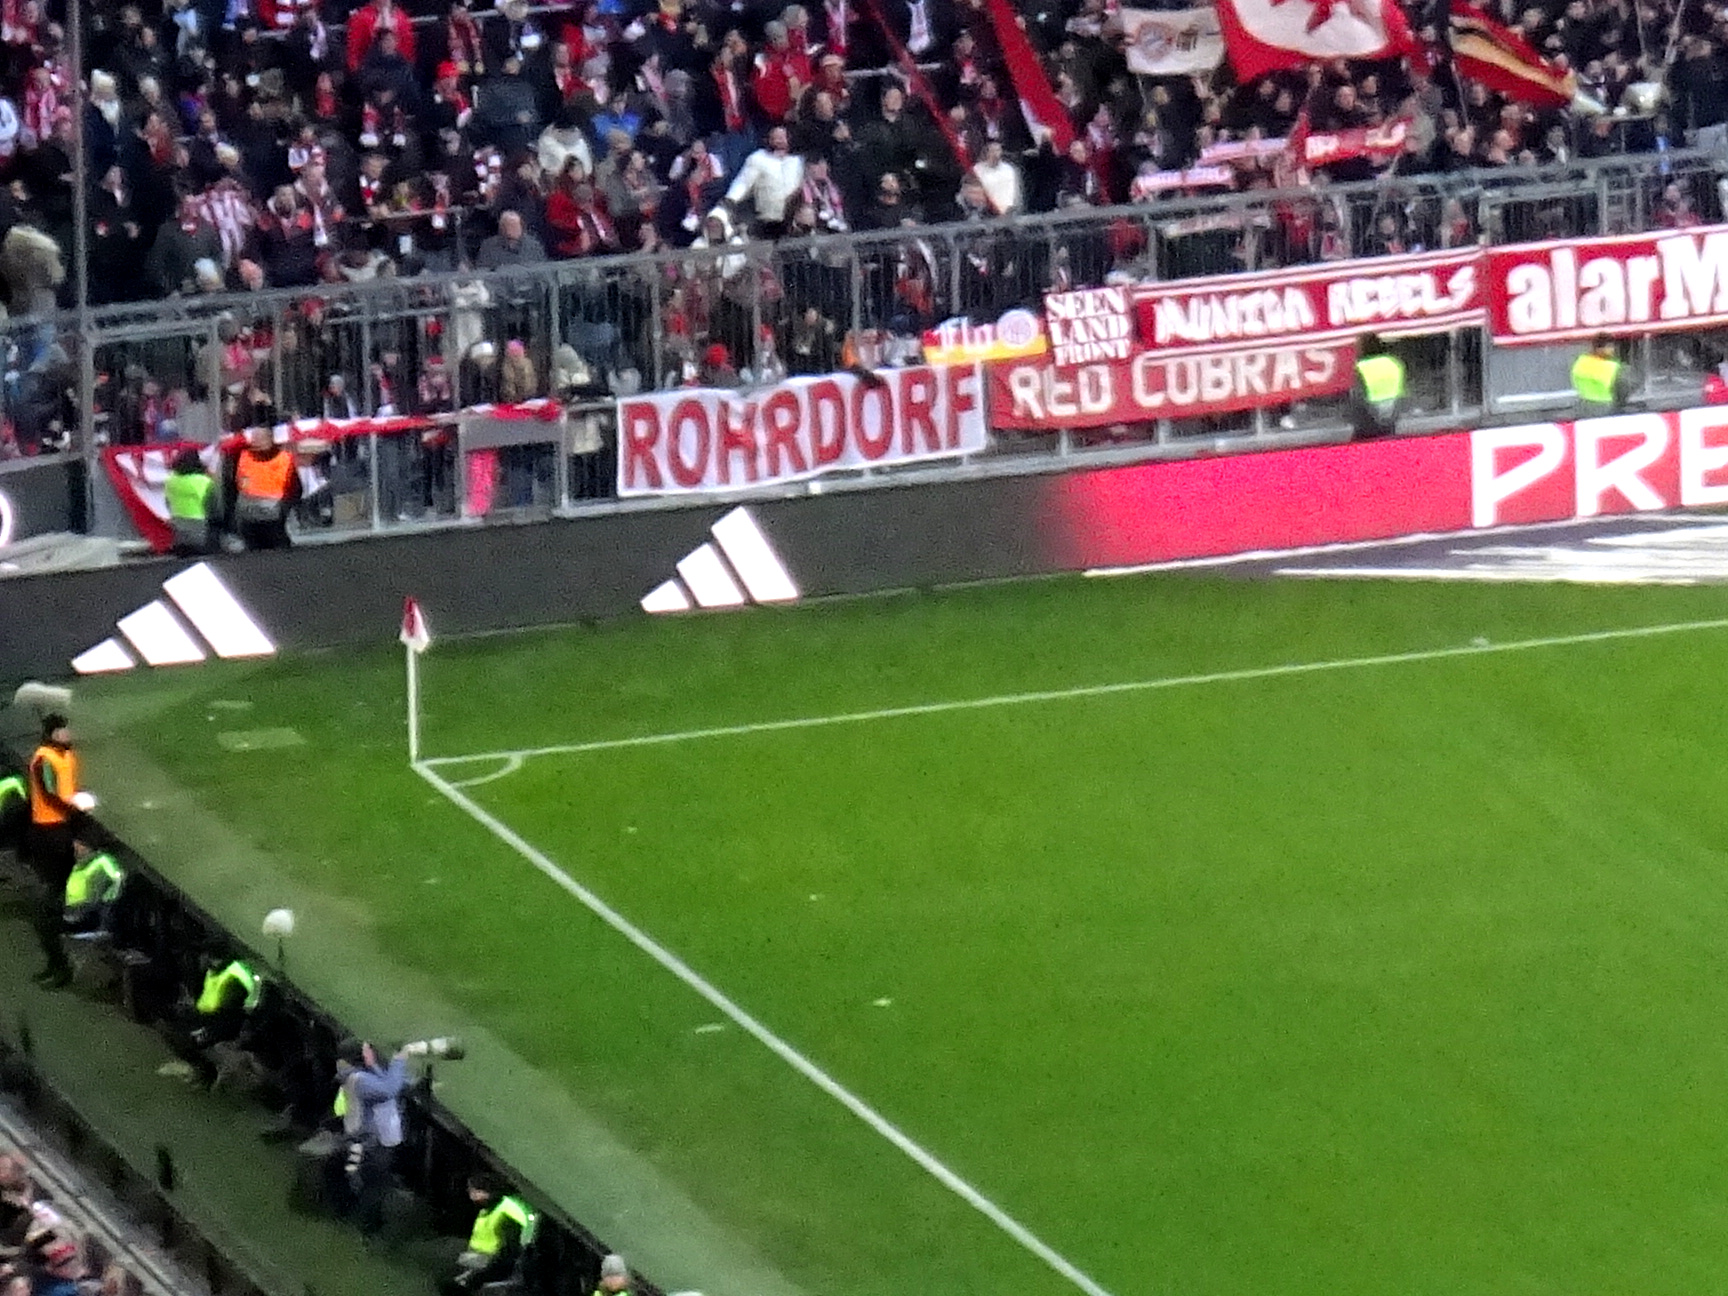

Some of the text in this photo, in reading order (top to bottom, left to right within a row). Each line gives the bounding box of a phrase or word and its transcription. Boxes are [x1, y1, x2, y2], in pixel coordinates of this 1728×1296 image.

[1046, 287, 1126, 320] SEEN
[1050, 312, 1131, 347] LAND
[1009, 348, 1337, 420] RED COBRAS
[622, 364, 977, 489] ROHRDORF
